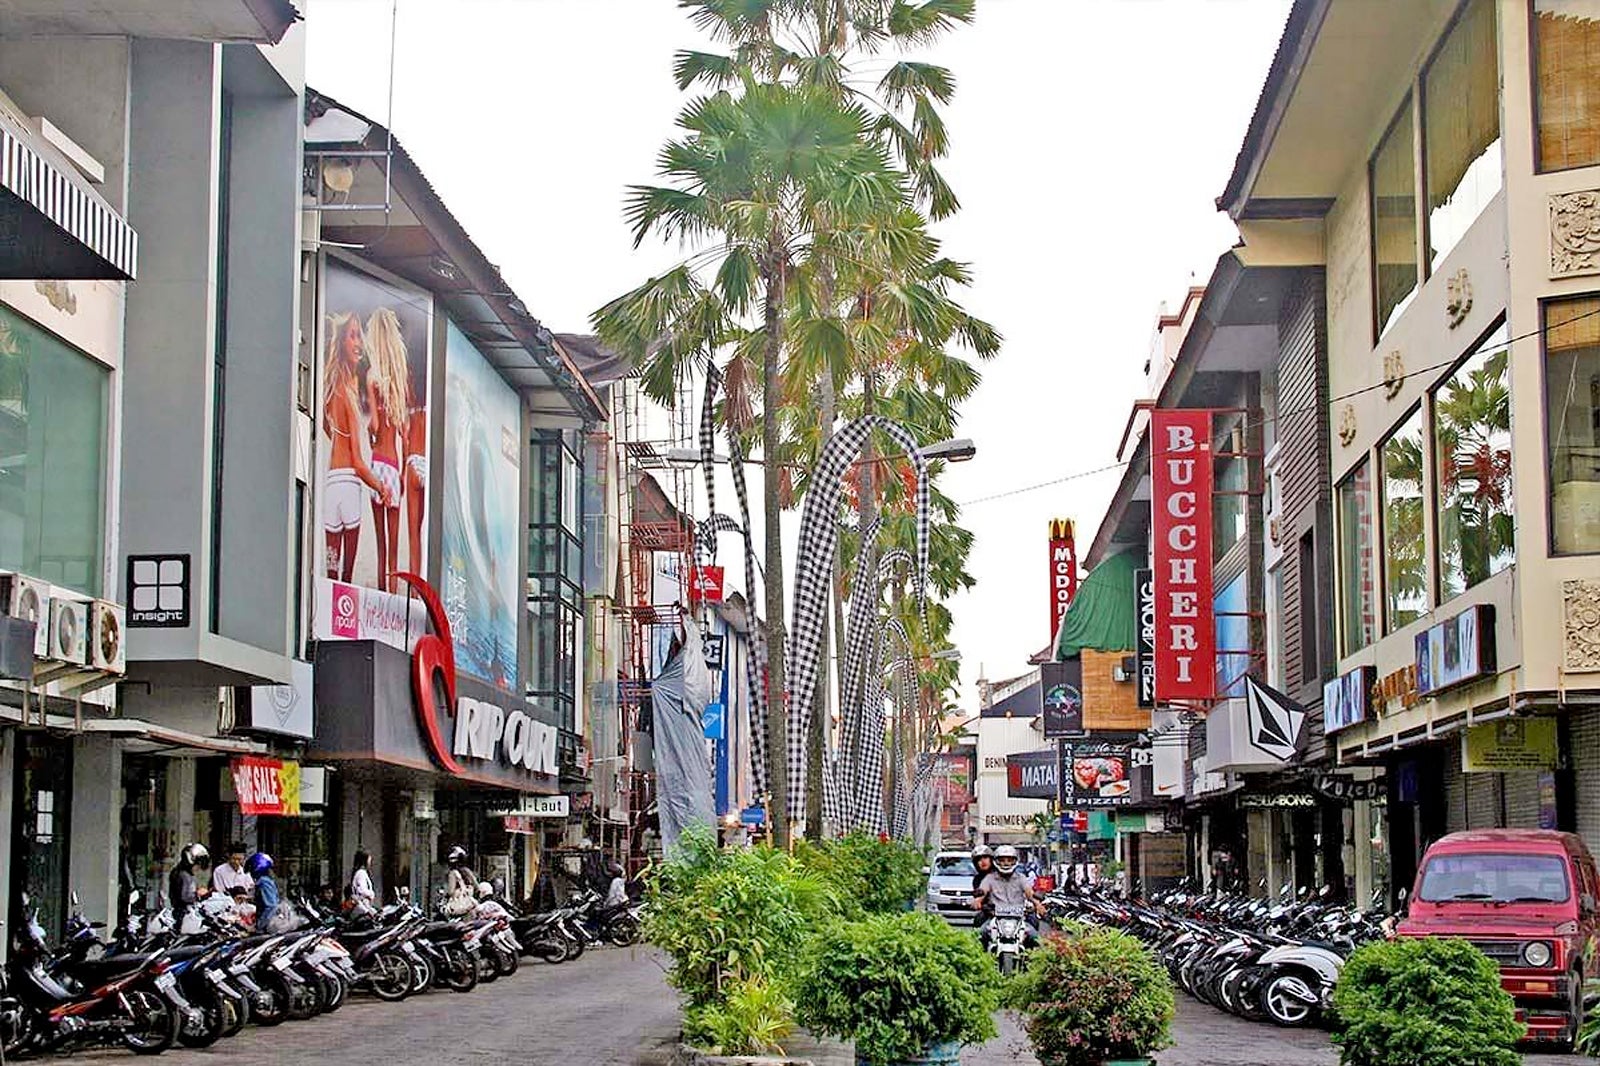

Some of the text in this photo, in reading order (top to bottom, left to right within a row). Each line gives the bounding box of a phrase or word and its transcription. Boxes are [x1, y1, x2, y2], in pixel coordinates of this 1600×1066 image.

[1053, 547, 1073, 624] McDon
[1165, 425, 1197, 683] BUCCHERI
[132, 611, 183, 622] insight
[454, 696, 559, 776] RIP CURL
[253, 765, 279, 804] SALE
